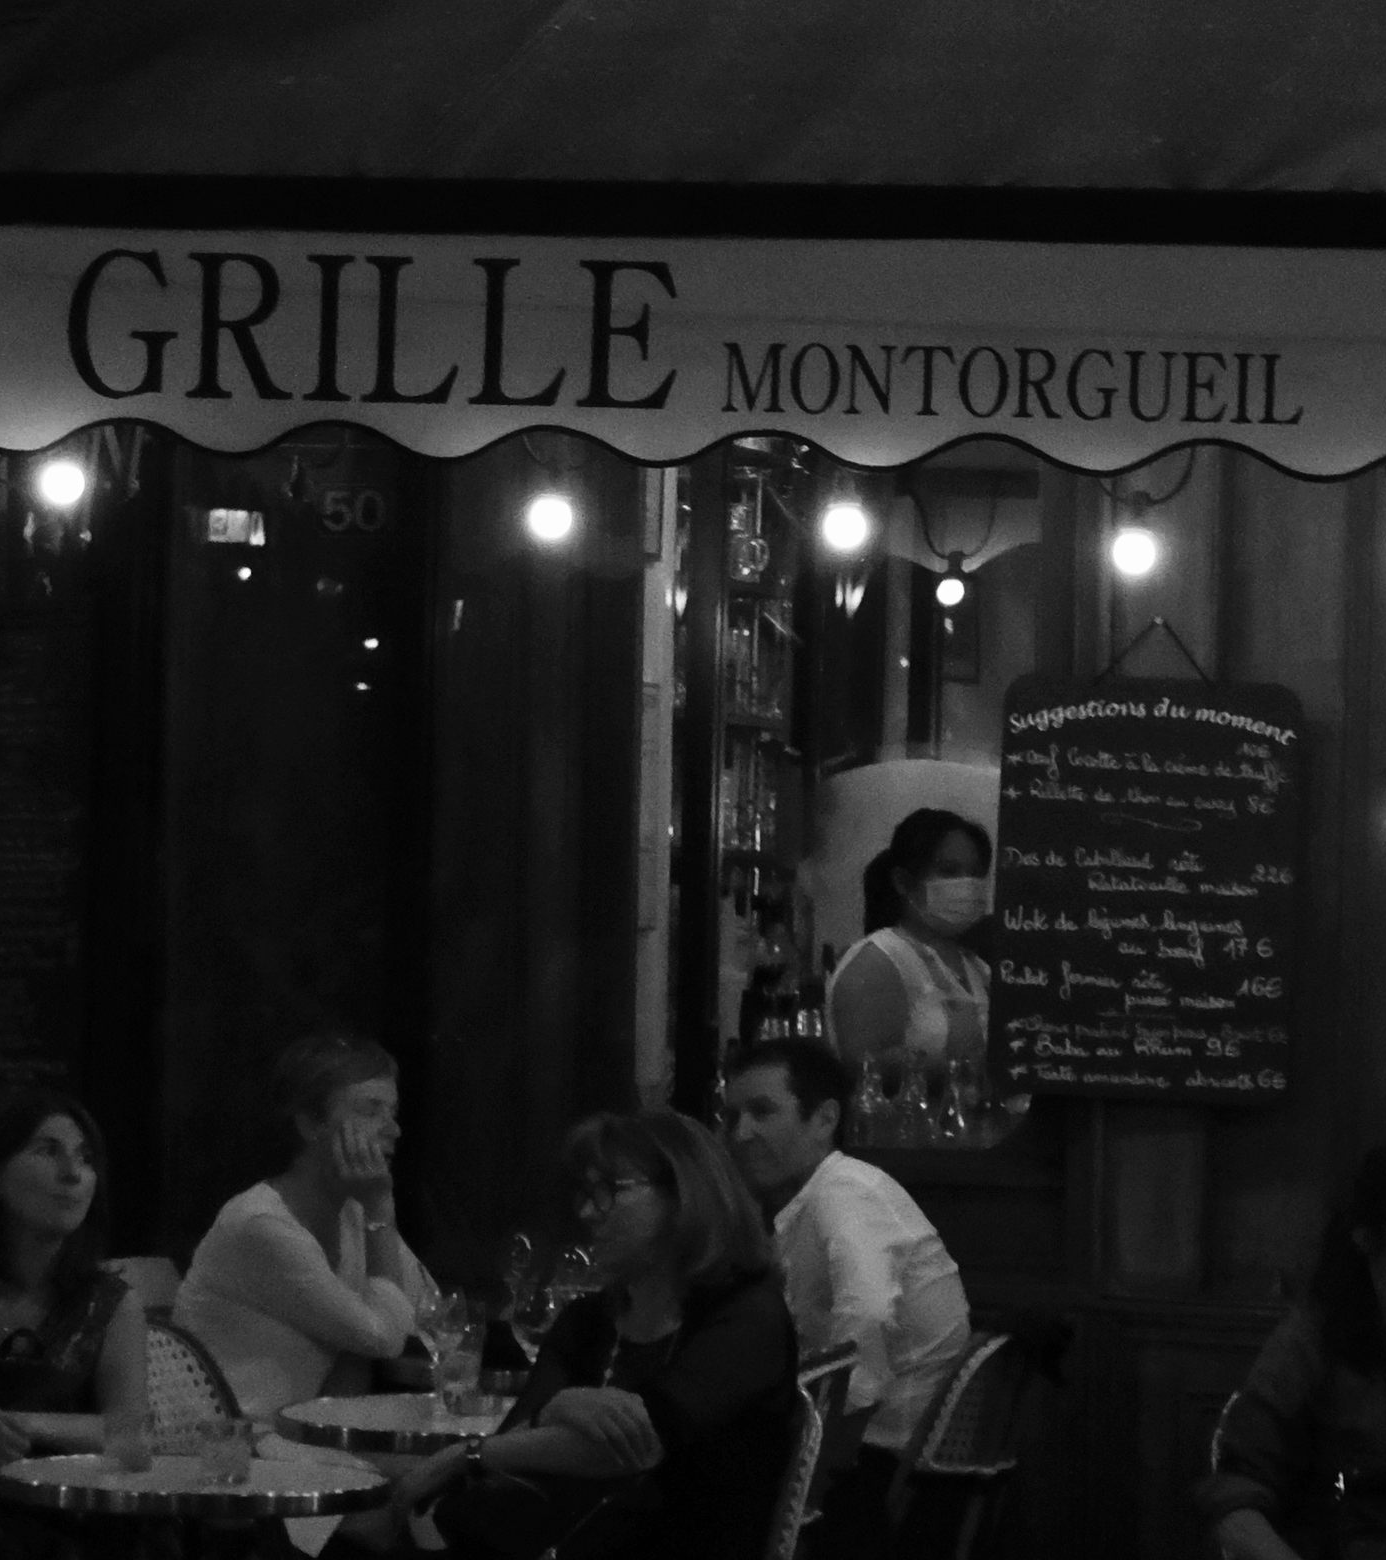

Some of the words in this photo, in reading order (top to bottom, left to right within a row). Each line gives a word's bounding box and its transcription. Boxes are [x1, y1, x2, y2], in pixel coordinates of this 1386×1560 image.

[66, 247, 678, 412] GRILLE
[722, 341, 1304, 428] MONTORGUEIL
[321, 488, 386, 533] 50
[1153, 696, 1191, 720] du
[1195, 707, 1299, 747] moment
[1003, 904, 1050, 933] Wok
[1053, 911, 1079, 933] de
